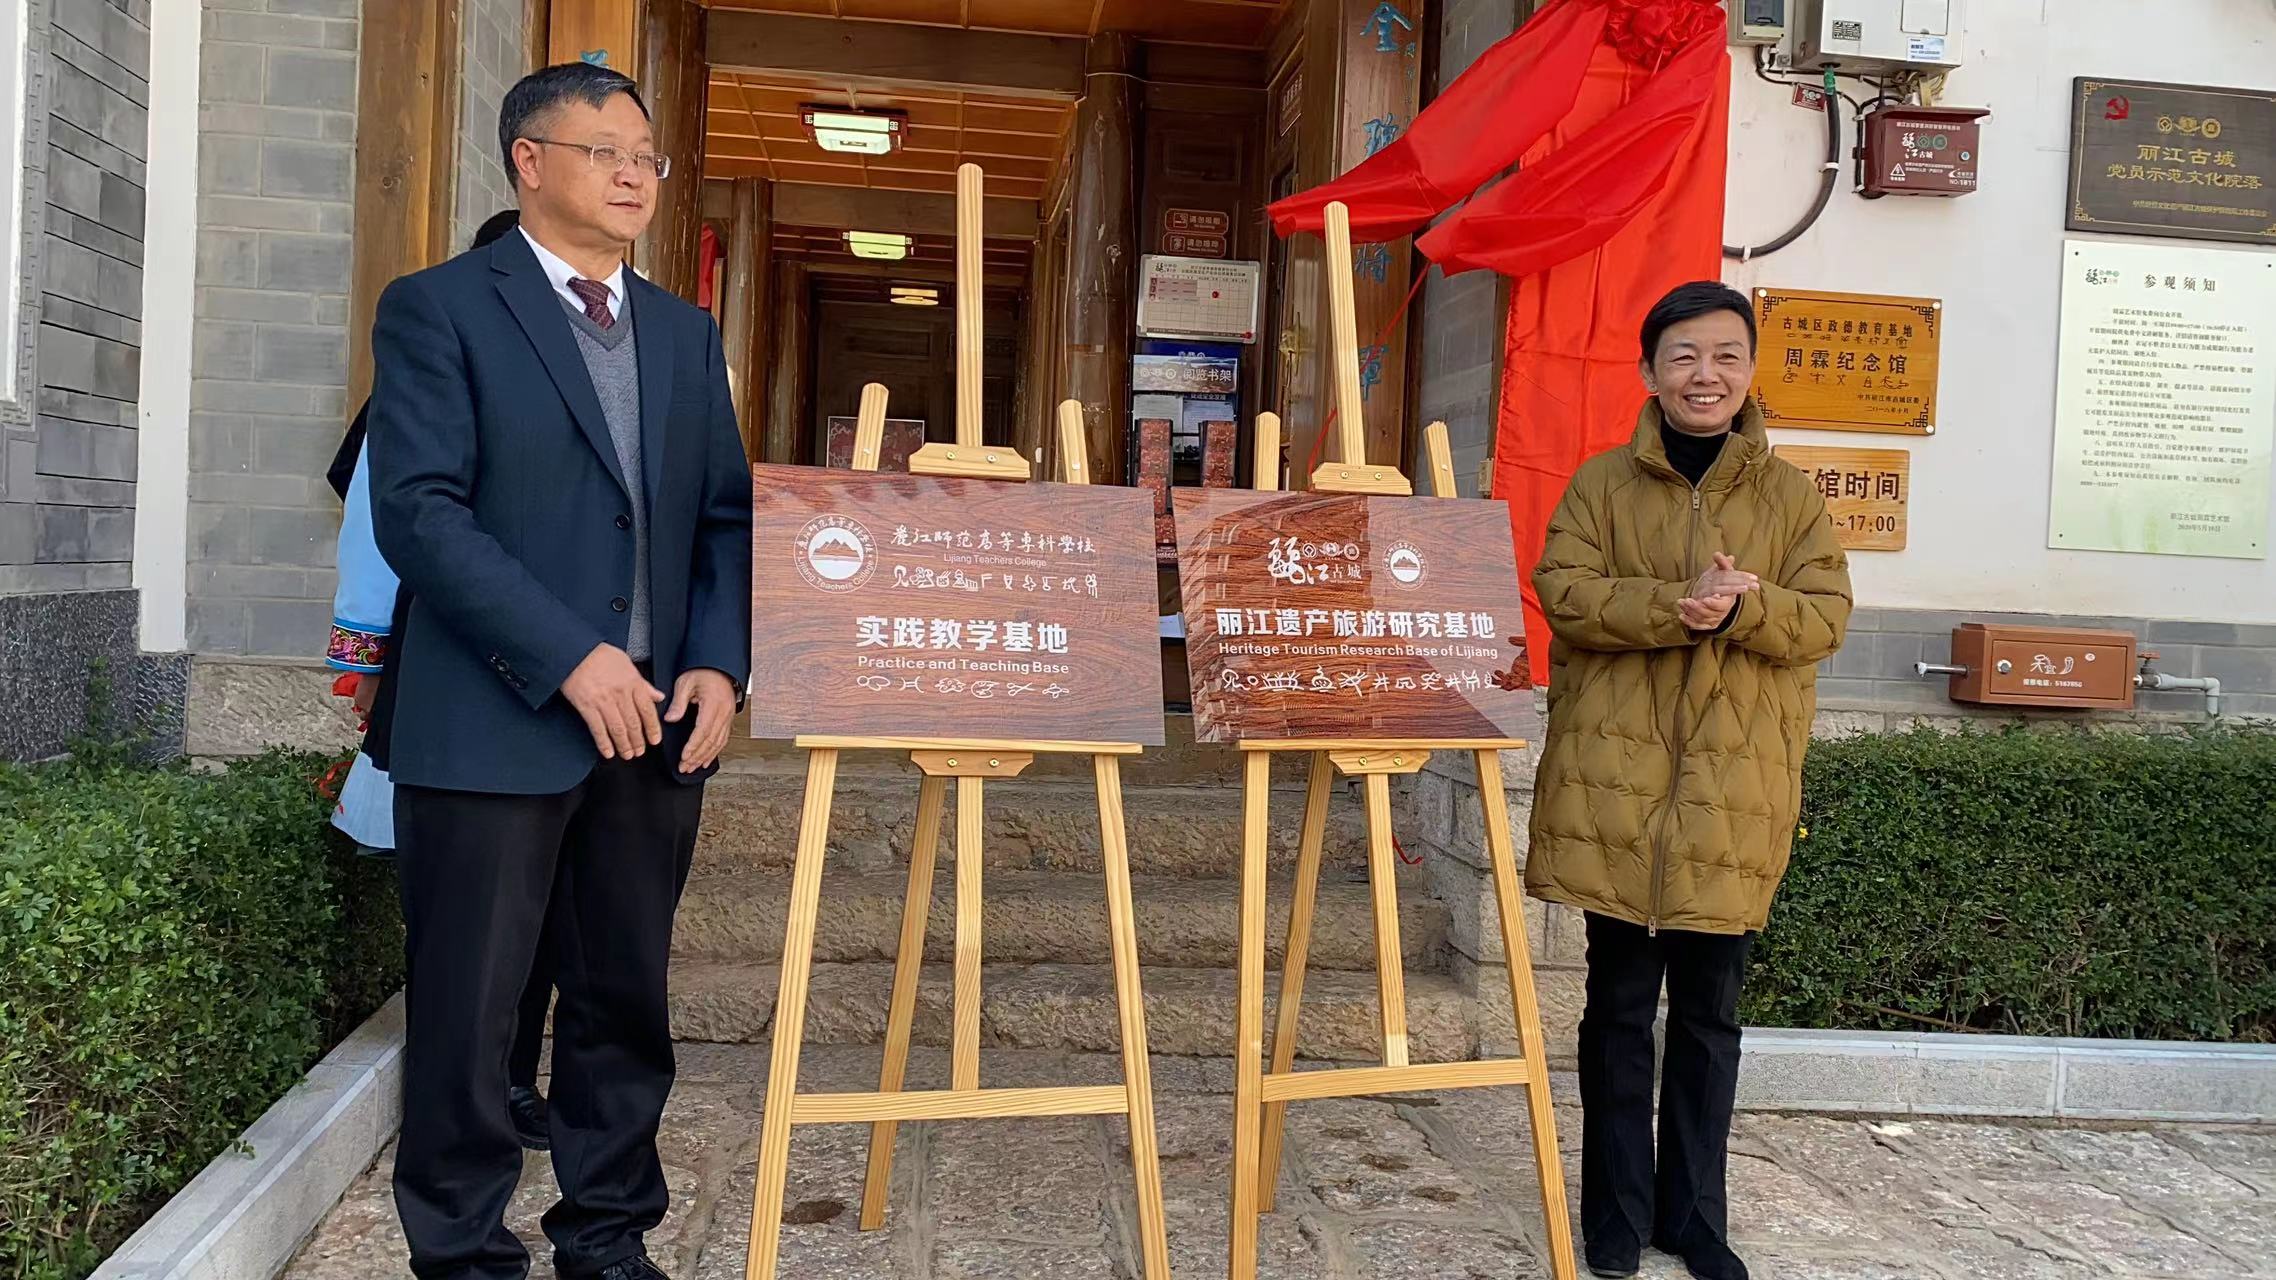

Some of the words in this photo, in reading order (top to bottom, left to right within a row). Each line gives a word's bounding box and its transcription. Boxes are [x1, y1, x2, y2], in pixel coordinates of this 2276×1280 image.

[2136, 143, 2237, 168] 丽江古城
[2106, 163, 2263, 189] 党员示范文化院落
[2143, 273, 2216, 292] 参观须知
[1783, 316, 1913, 338] 古城区政德教育基地
[1784, 347, 1908, 375] 周霖纪念馆
[1183, 367, 1232, 382] 阅览书架
[1801, 468, 1900, 500] 馆时间
[944, 553, 972, 565] Lijiang
[973, 554, 1014, 566] Teachers
[1014, 556, 1047, 568] College
[855, 615, 1069, 654] 实践教学基地
[1215, 608, 1496, 639] 丽江遗产旅游研究基地
[1218, 642, 1280, 657] Heritage
[1281, 643, 1339, 656] Tourism
[1340, 644, 1404, 656] Research
[1406, 645, 1438, 657] Base
[1440, 645, 1455, 657] of
[1456, 645, 1498, 660] Lijiang
[858, 655, 927, 670] Practice
[928, 657, 956, 670] and
[959, 658, 1030, 675] Teaching
[1032, 661, 1069, 674] Base
